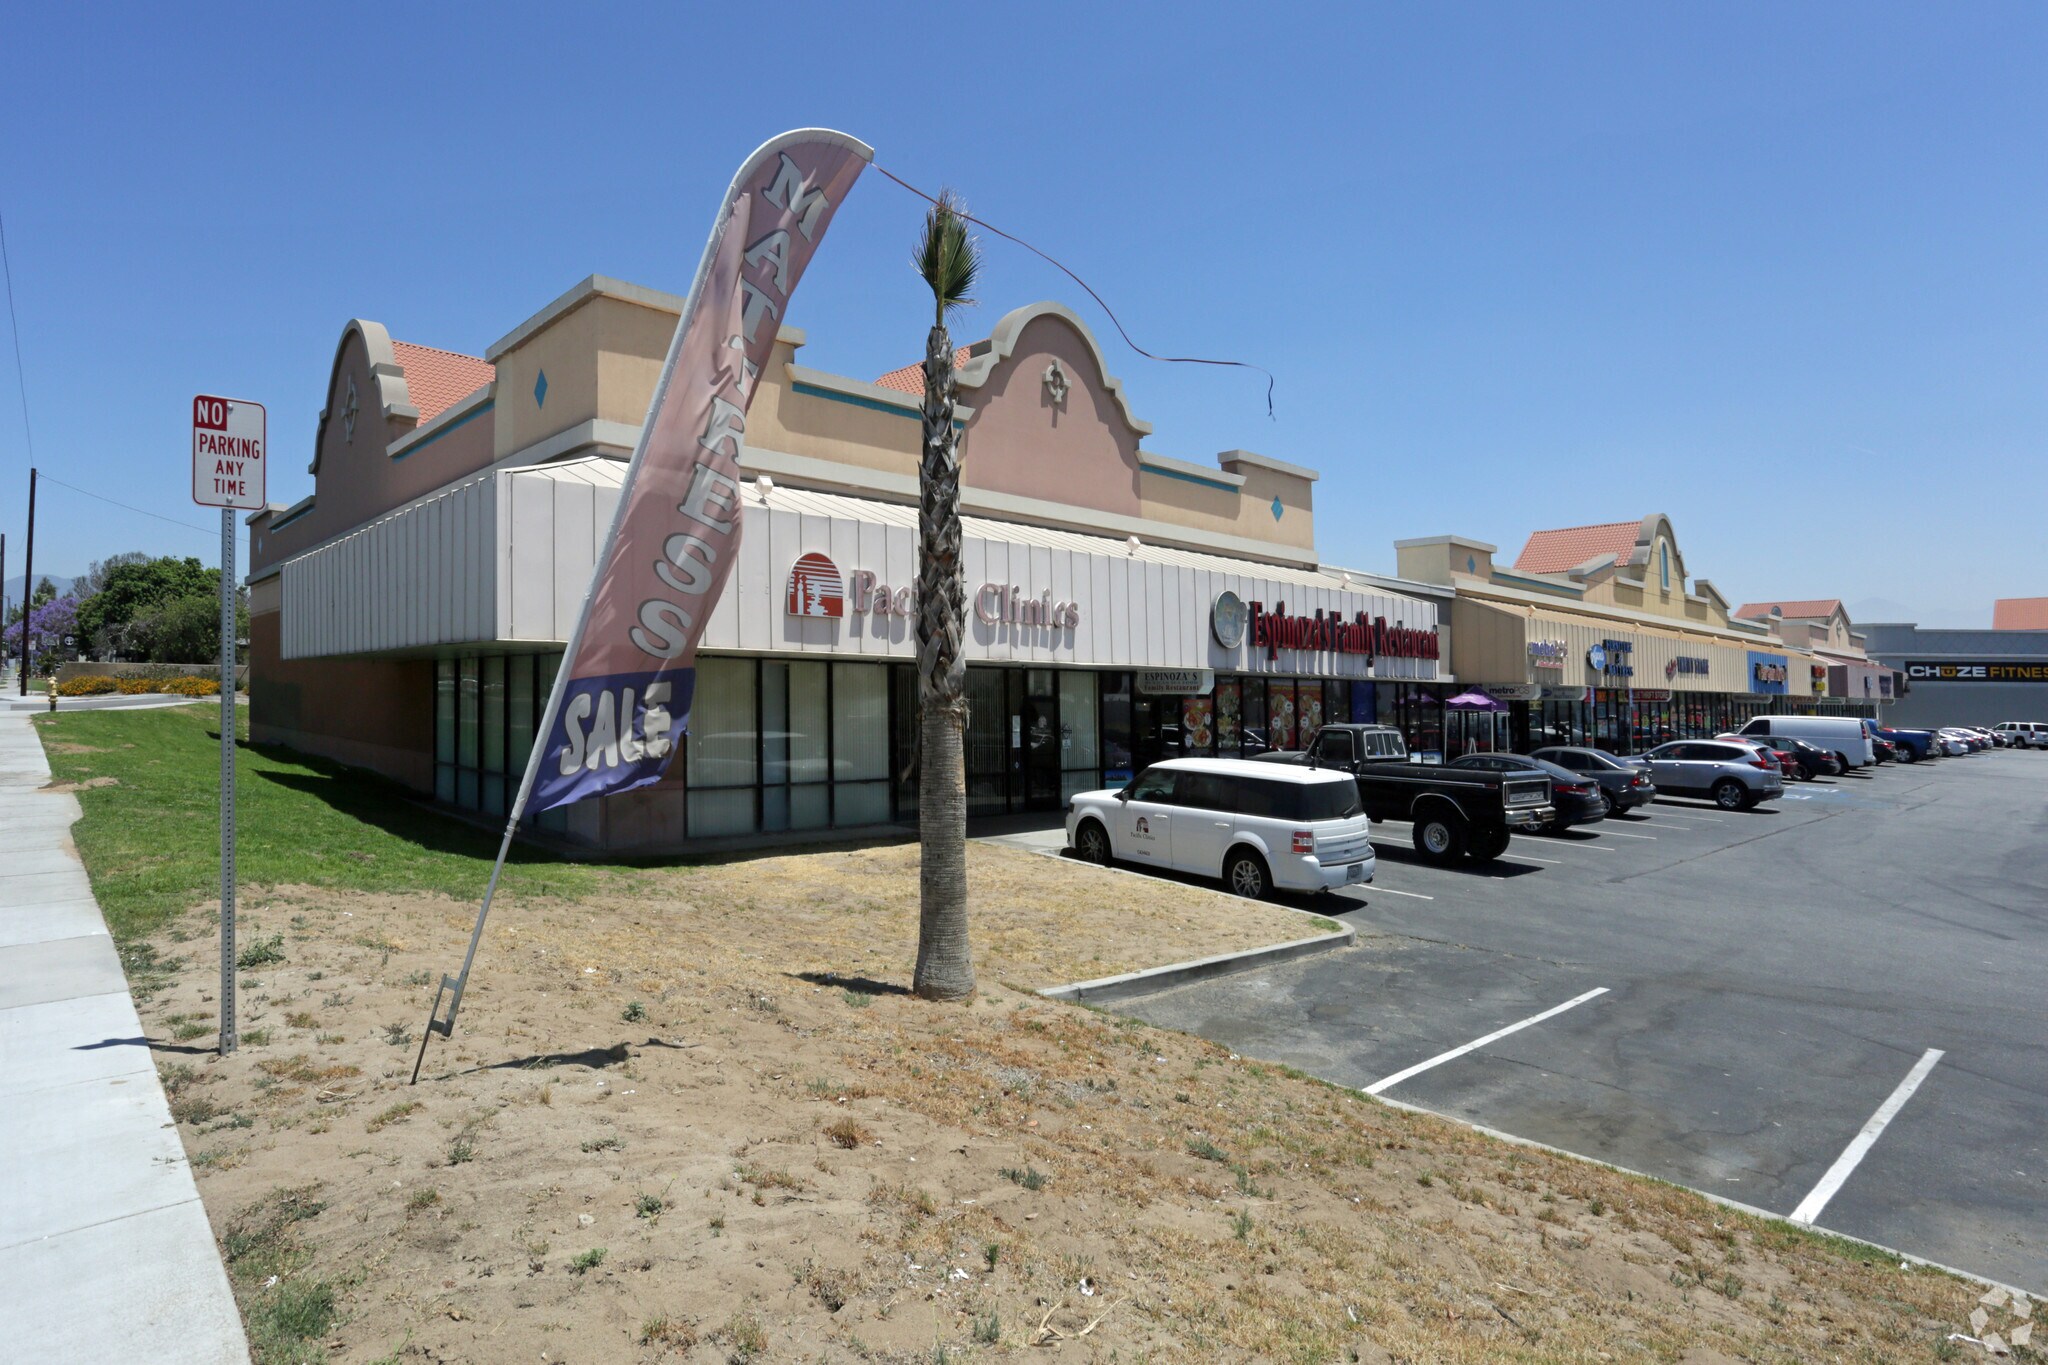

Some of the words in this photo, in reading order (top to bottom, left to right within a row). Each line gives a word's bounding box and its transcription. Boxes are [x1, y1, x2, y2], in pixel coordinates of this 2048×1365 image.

[197, 400, 223, 426] NO
[200, 433, 260, 459] PARKING
[215, 459, 244, 476] ANY
[214, 478, 246, 496] TIME
[975, 583, 1080, 629] Clinics
[1250, 600, 1331, 660] Espinoza's
[1330, 610, 1376, 667] Family
[1377, 616, 1440, 660] Restaurant
[1489, 685, 1530, 695] metroPCS
[560, 681, 672, 776] SALE
